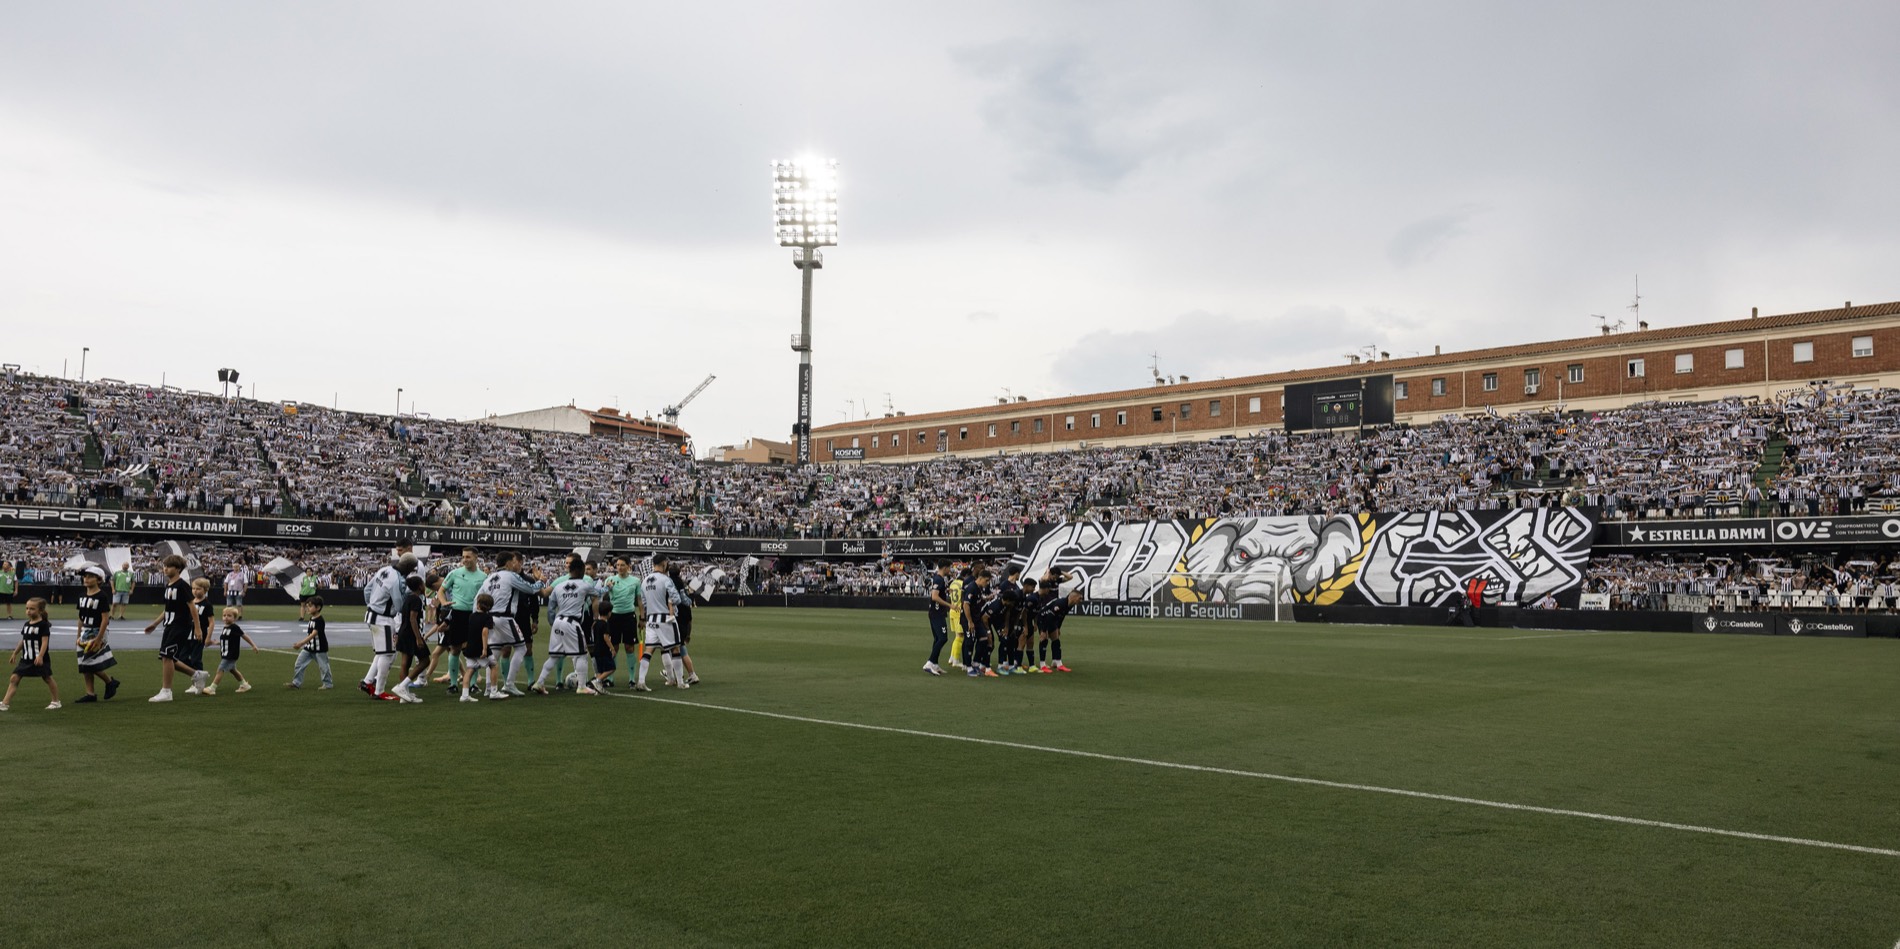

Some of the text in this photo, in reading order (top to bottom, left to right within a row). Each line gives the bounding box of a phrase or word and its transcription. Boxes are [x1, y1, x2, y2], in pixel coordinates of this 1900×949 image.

[0, 508, 119, 523] REPCAR
[148, 519, 238, 533] ESTRELLA DAMM
[285, 524, 312, 533] CDCS
[1777, 521, 1833, 540] OVE
[1649, 527, 1766, 541] ESTRELLA DAMM
[627, 537, 679, 547] IBEROCLAYS
[959, 543, 980, 552] MGS
[1082, 602, 1112, 617] viejo
[1115, 604, 1160, 618] campo
[1165, 604, 1185, 618] del
[1190, 604, 1242, 620] Sequiol
[1720, 620, 1764, 628] CDCastellón
[1806, 622, 1854, 631] CDCastellón
